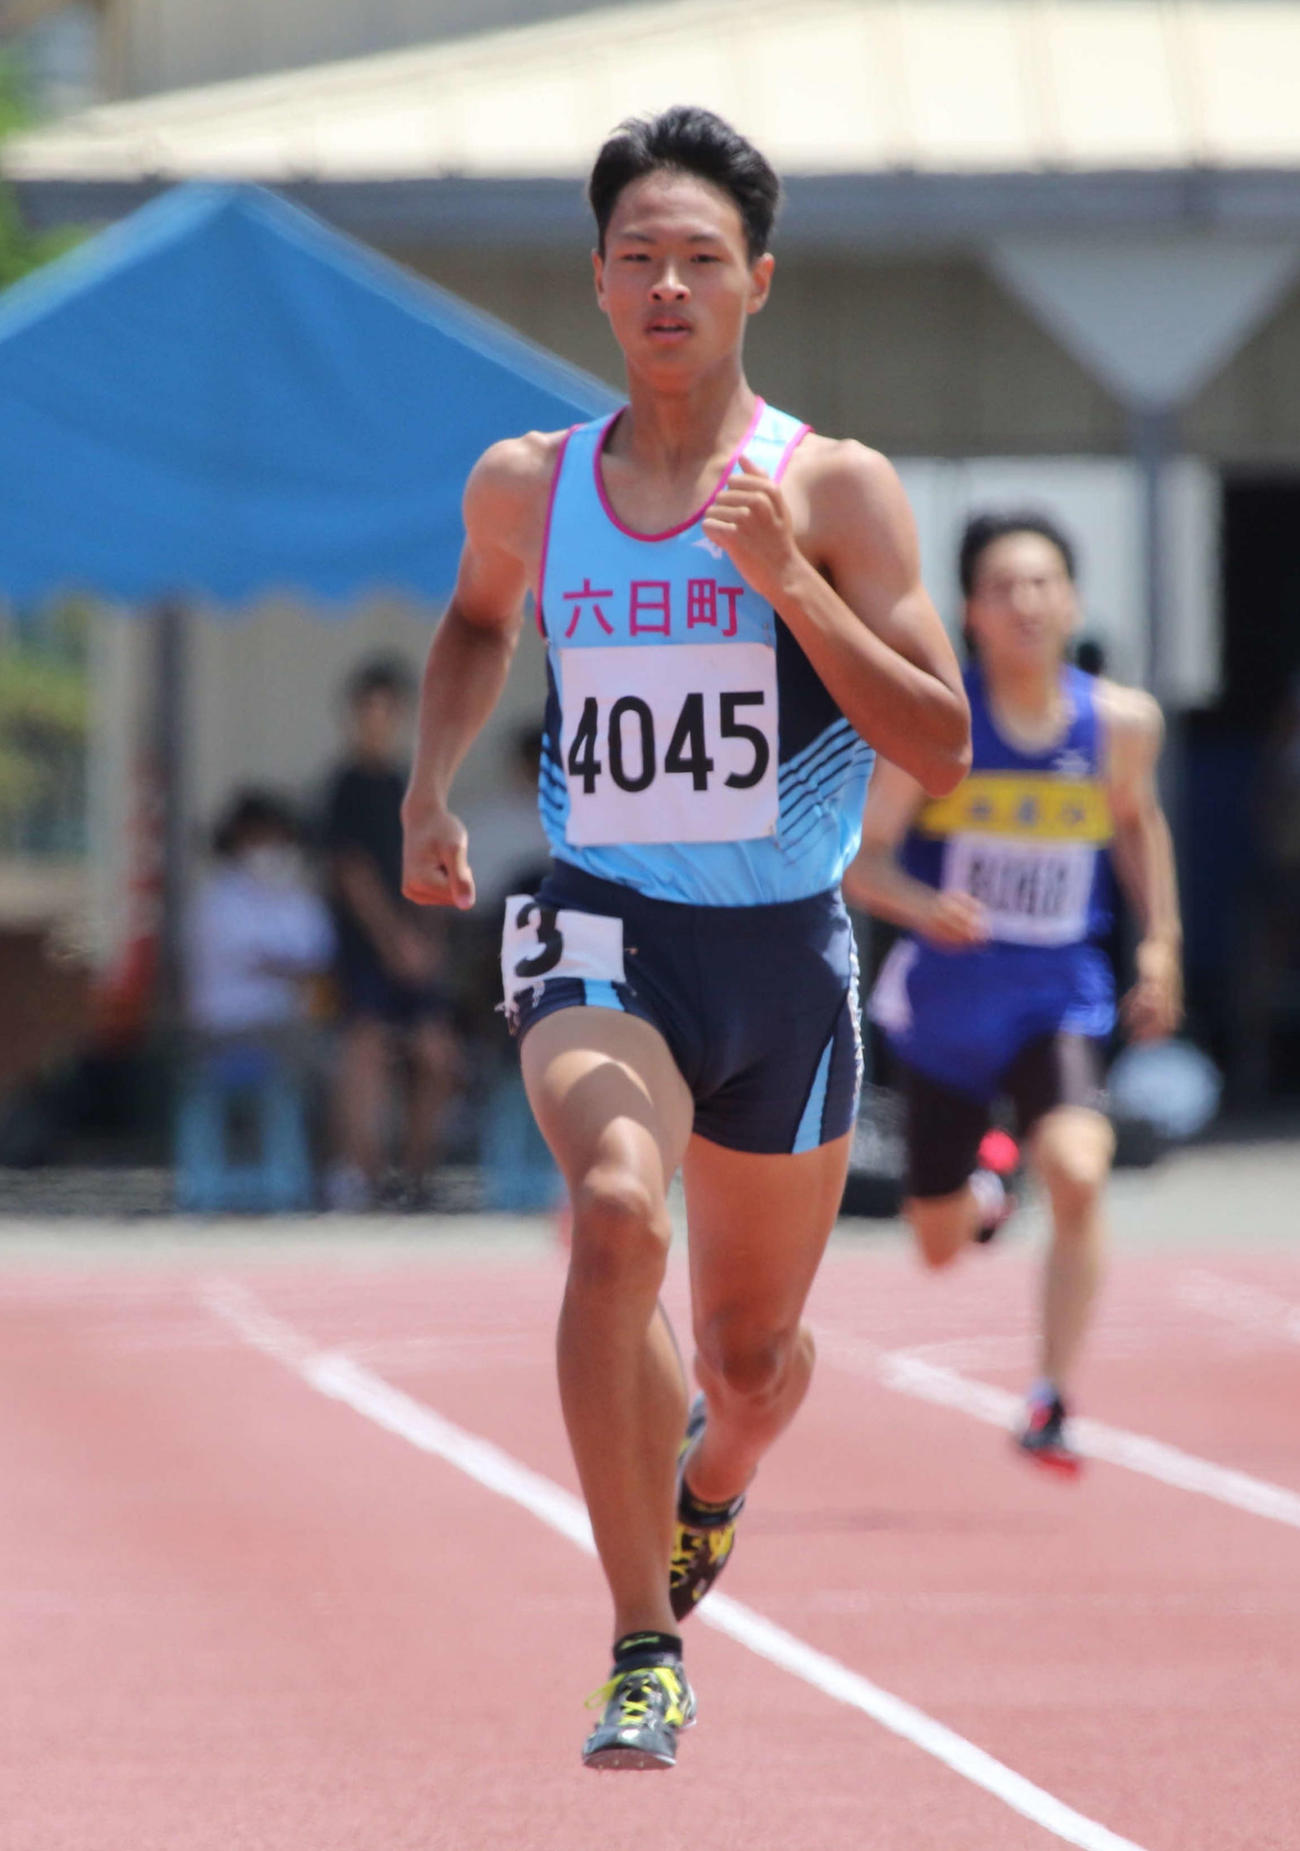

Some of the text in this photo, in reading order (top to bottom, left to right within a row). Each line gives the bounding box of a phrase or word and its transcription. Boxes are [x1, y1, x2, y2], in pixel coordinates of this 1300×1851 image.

[562, 578, 745, 638] 六日町
[568, 691, 770, 795] 4045
[514, 901, 563, 977] 3
